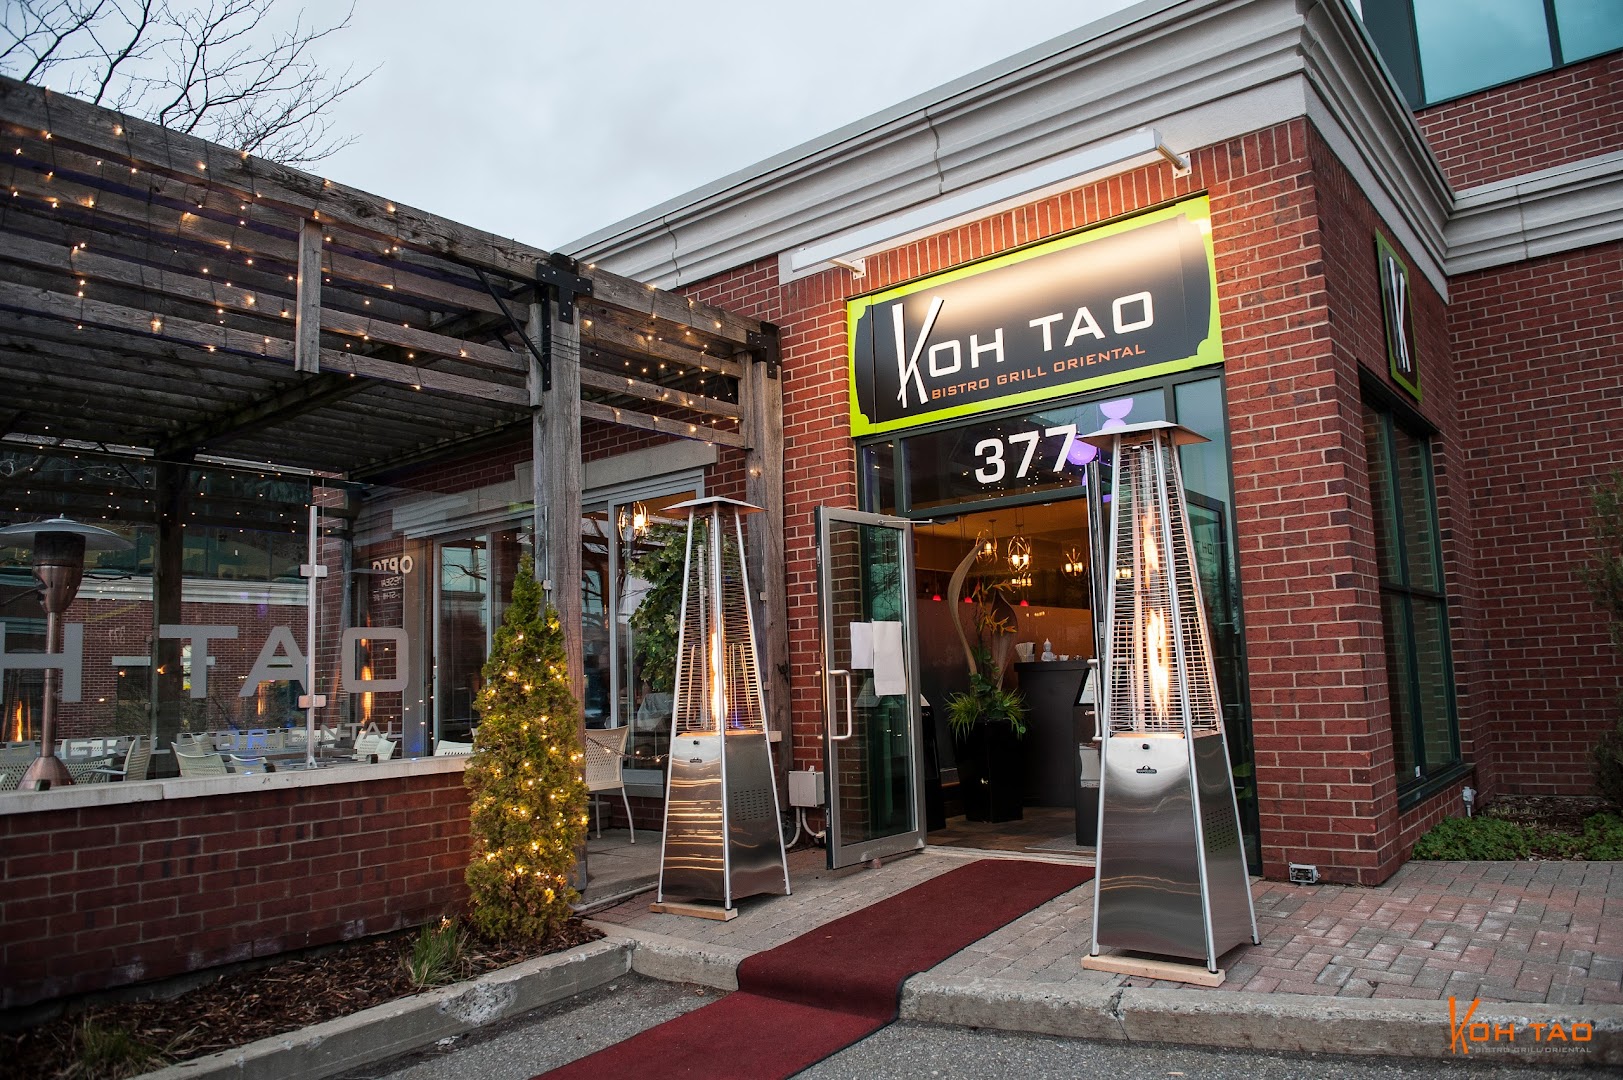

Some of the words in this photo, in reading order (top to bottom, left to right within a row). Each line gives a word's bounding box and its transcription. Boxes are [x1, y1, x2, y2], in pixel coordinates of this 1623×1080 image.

[892, 296, 1004, 408] KOH
[1029, 291, 1154, 351] TAO
[931, 378, 990, 400] BISTRO
[996, 366, 1047, 386] GRILL
[1053, 344, 1146, 373] ORIENTAL
[974, 423, 1077, 484] 377
[159, 625, 409, 698] TAO
[216, 720, 401, 751] ORIENTAL
